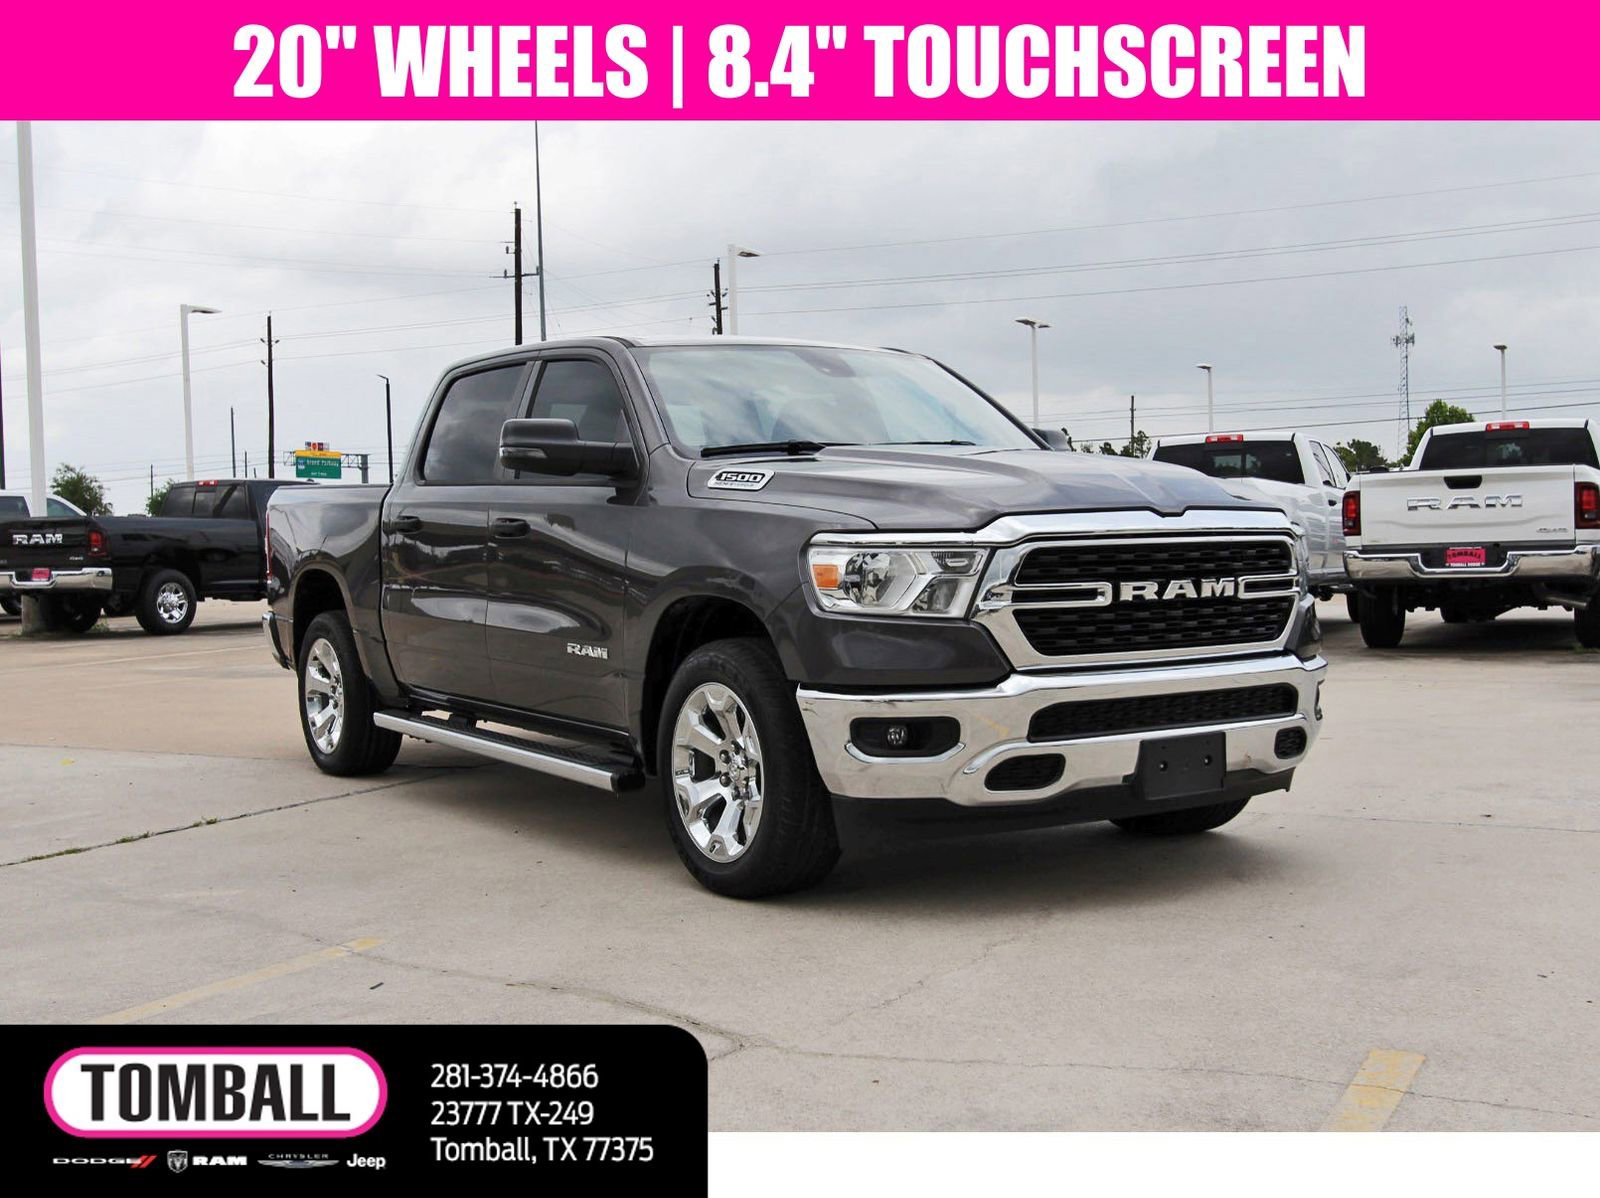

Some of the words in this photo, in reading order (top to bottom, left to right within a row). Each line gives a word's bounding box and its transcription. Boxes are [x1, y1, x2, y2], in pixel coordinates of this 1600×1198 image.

[720, 472, 763, 482] 1500
[1407, 494, 1523, 511] RAM
[12, 533, 63, 545] RAM
[1119, 577, 1236, 601] RAM
[567, 642, 608, 660] RAM
